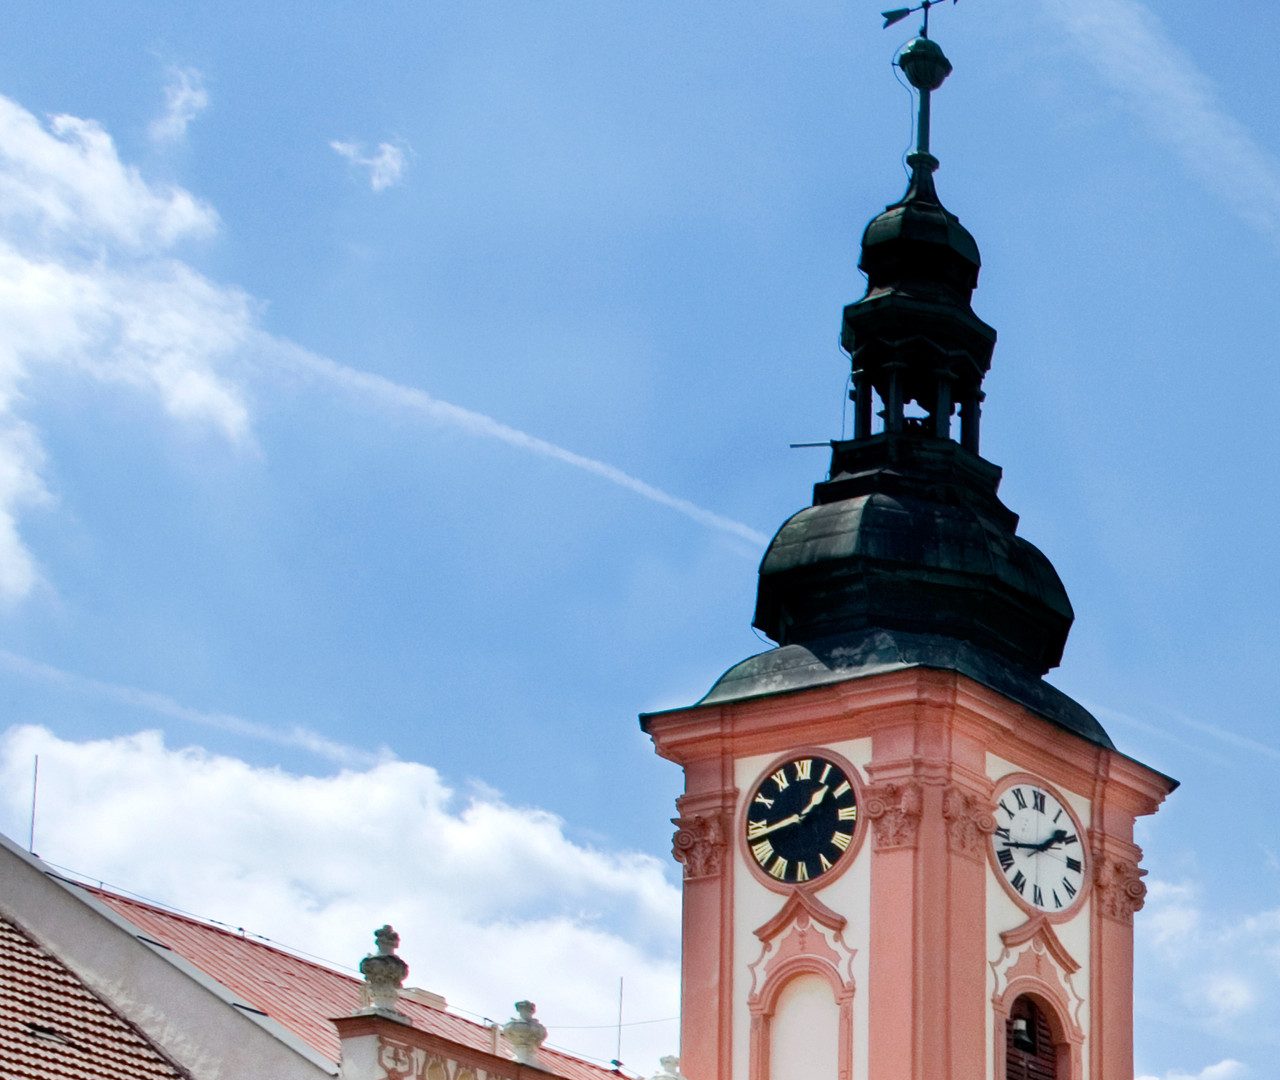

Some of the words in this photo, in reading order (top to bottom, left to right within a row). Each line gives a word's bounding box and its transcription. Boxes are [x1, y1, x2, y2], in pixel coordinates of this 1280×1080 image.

[771, 768, 790, 793] XI
[794, 760, 812, 781] XII
[819, 763, 832, 784] I
[755, 792, 775, 810] X
[999, 799, 1015, 820] X
[1012, 788, 1028, 810] XI
[1032, 790, 1046, 815] XII
[838, 805, 857, 821] III
[1053, 809, 1063, 824] I
[831, 831, 852, 852] IIII
[995, 825, 1010, 842] IX
[752, 839, 774, 867] VIII
[819, 853, 833, 872] V
[769, 856, 788, 880] VII
[797, 861, 809, 881] VI
[1066, 856, 1081, 874] III
[1011, 870, 1027, 895] VII
[1062, 877, 1077, 899] IV
[1033, 884, 1044, 907] VI
[1052, 888, 1062, 908] V
